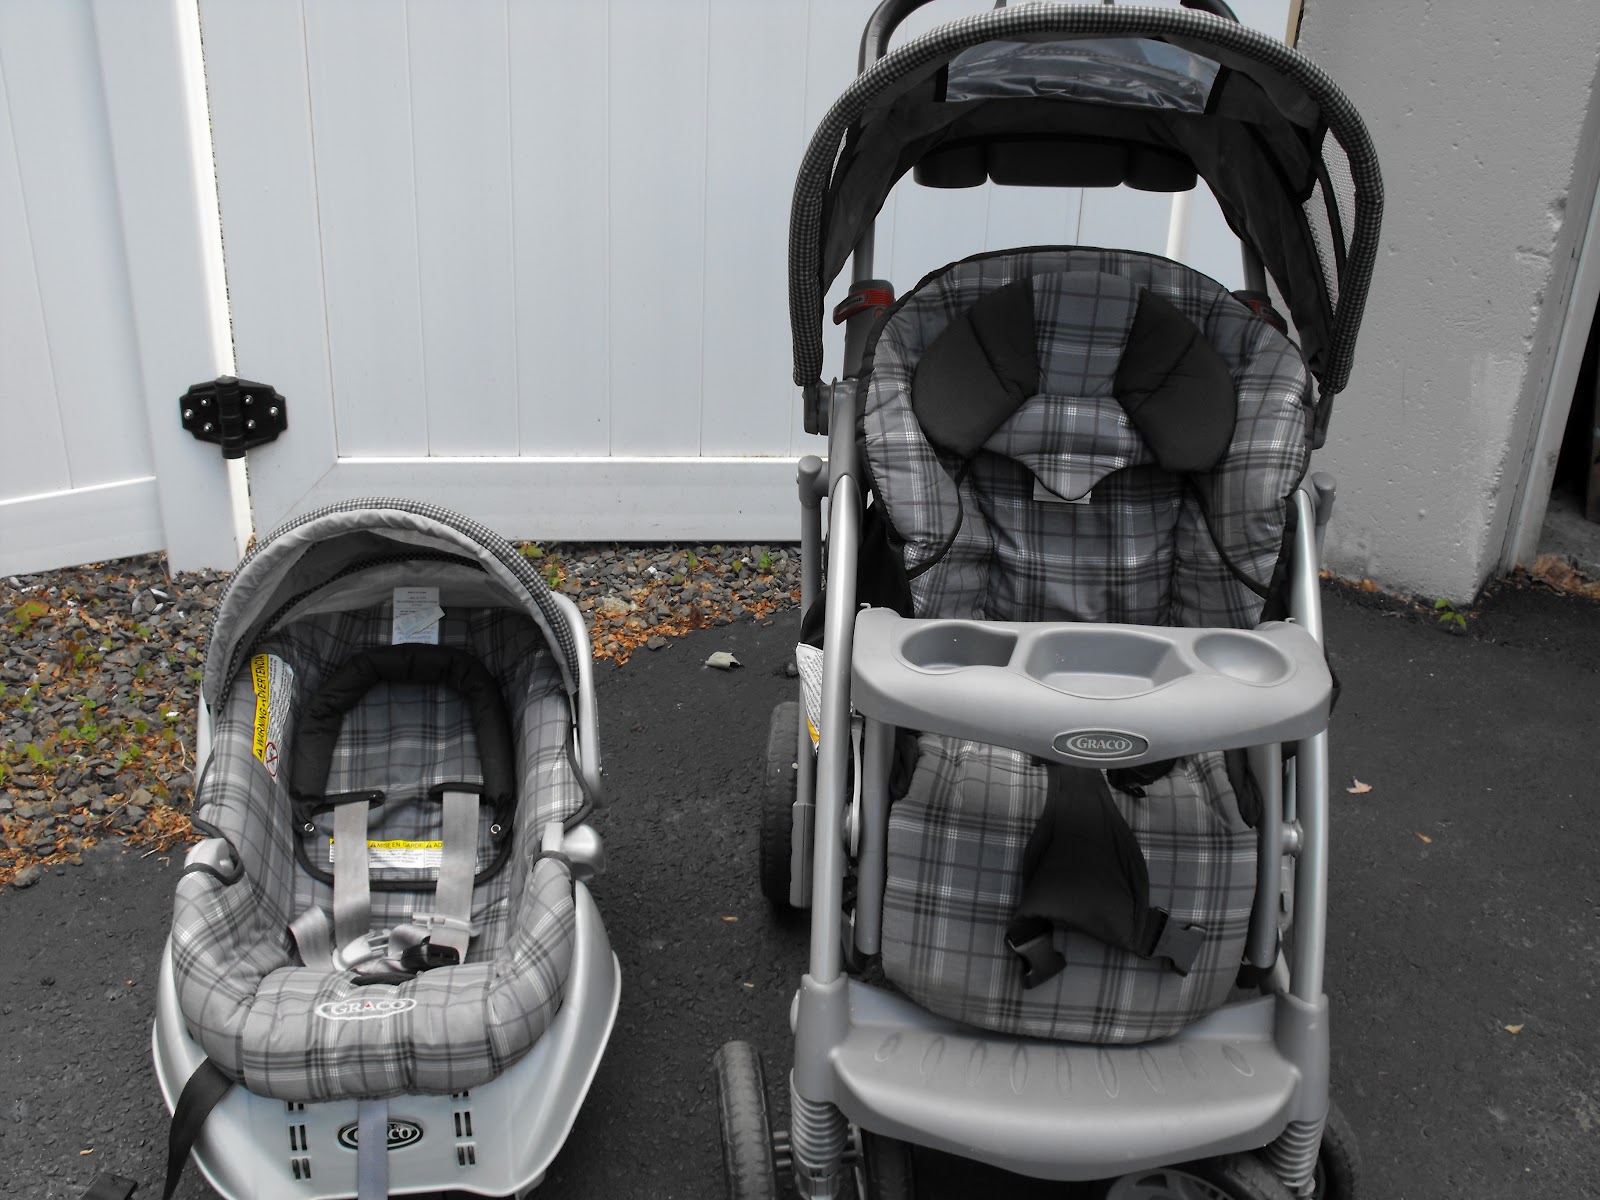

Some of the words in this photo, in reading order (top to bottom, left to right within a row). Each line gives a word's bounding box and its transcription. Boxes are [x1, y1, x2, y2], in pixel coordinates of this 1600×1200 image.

[256, 707, 267, 747] WARNING
[1076, 737, 1126, 750] GRACO
[330, 1001, 406, 1015] GRACO
